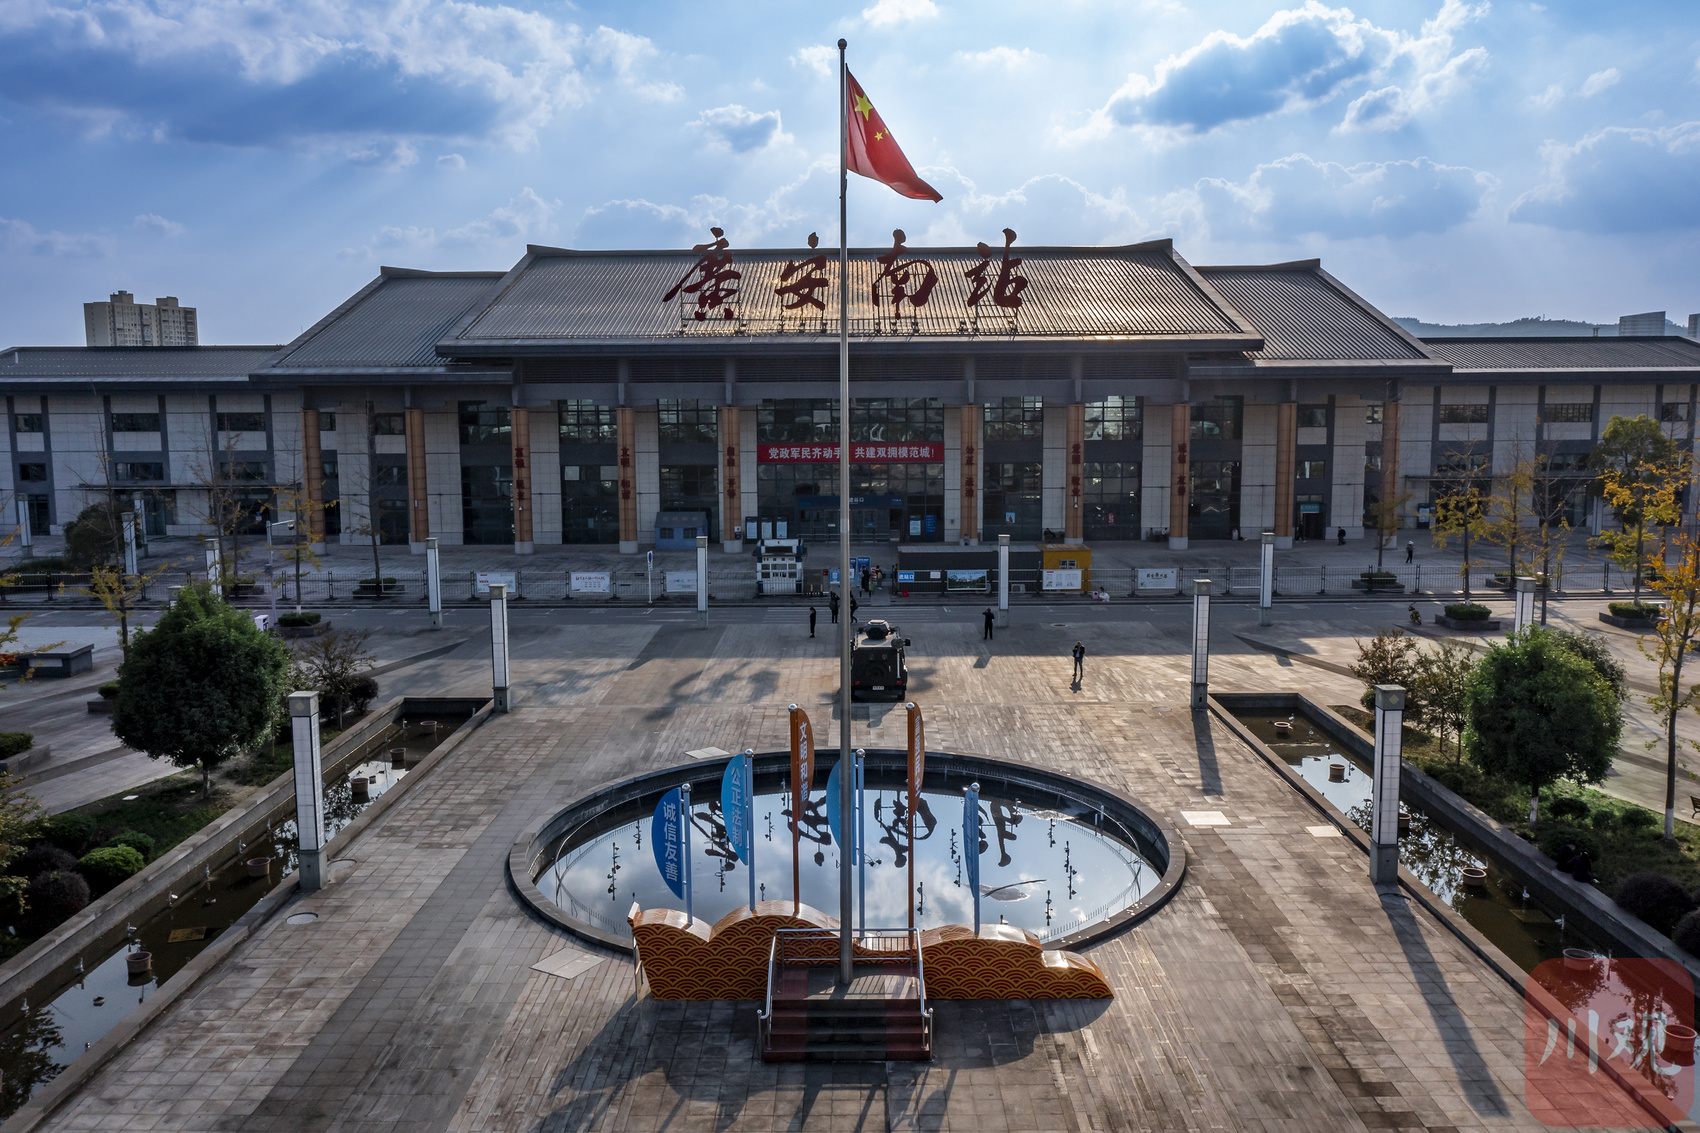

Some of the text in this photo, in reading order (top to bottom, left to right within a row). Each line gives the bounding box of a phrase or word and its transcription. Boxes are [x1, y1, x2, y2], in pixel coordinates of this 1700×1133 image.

[769, 446, 935, 459] 党政军民齐动手 共建双拥模范城!
[663, 801, 679, 882] 诚信友善
